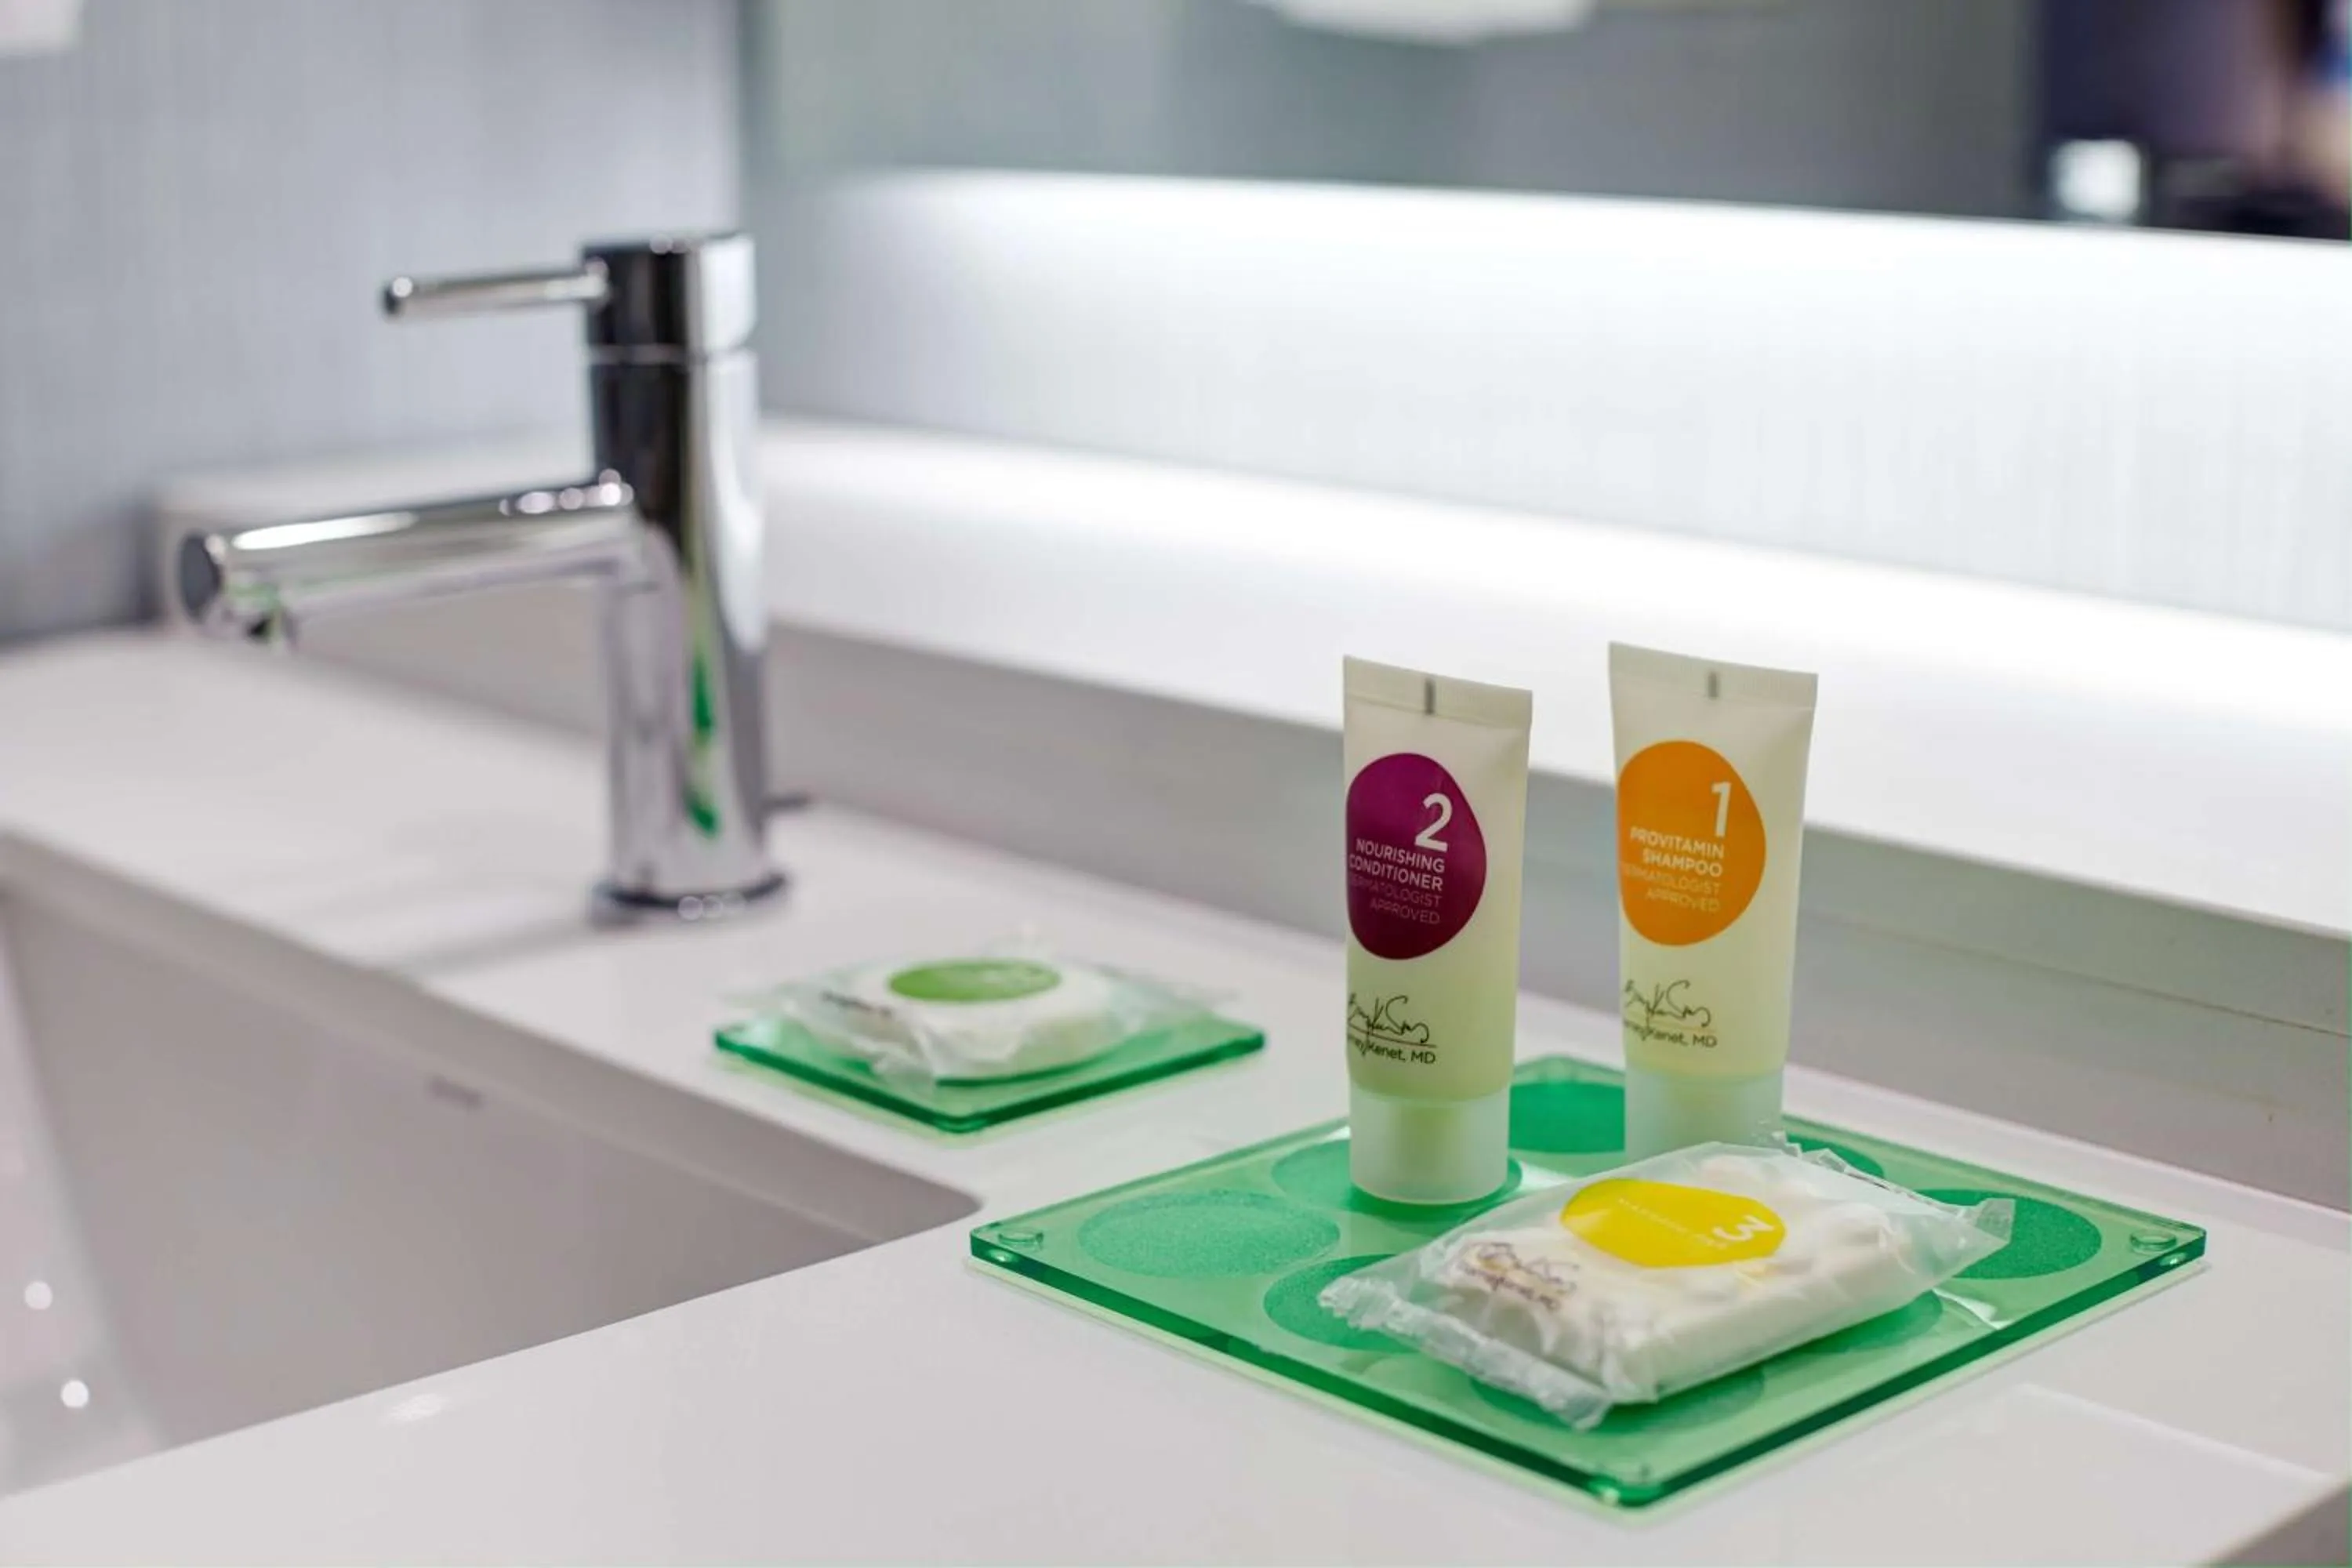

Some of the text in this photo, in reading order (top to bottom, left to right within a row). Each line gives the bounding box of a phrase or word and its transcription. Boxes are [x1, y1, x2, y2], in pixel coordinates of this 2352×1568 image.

[1414, 793, 1453, 852] 2
[1711, 782, 1733, 837] 1
[1356, 837, 1446, 873] NOURISHING
[1630, 826, 1725, 858] PROVITAMIN
[1348, 853, 1443, 891] CONDITIONER
[1642, 848, 1723, 877] SHAMPOO
[1370, 897, 1440, 924] APPROVED
[1644, 887, 1721, 913] APPROVED
[1693, 1033, 1718, 1048] MD
[1410, 1049, 1436, 1064] MD
